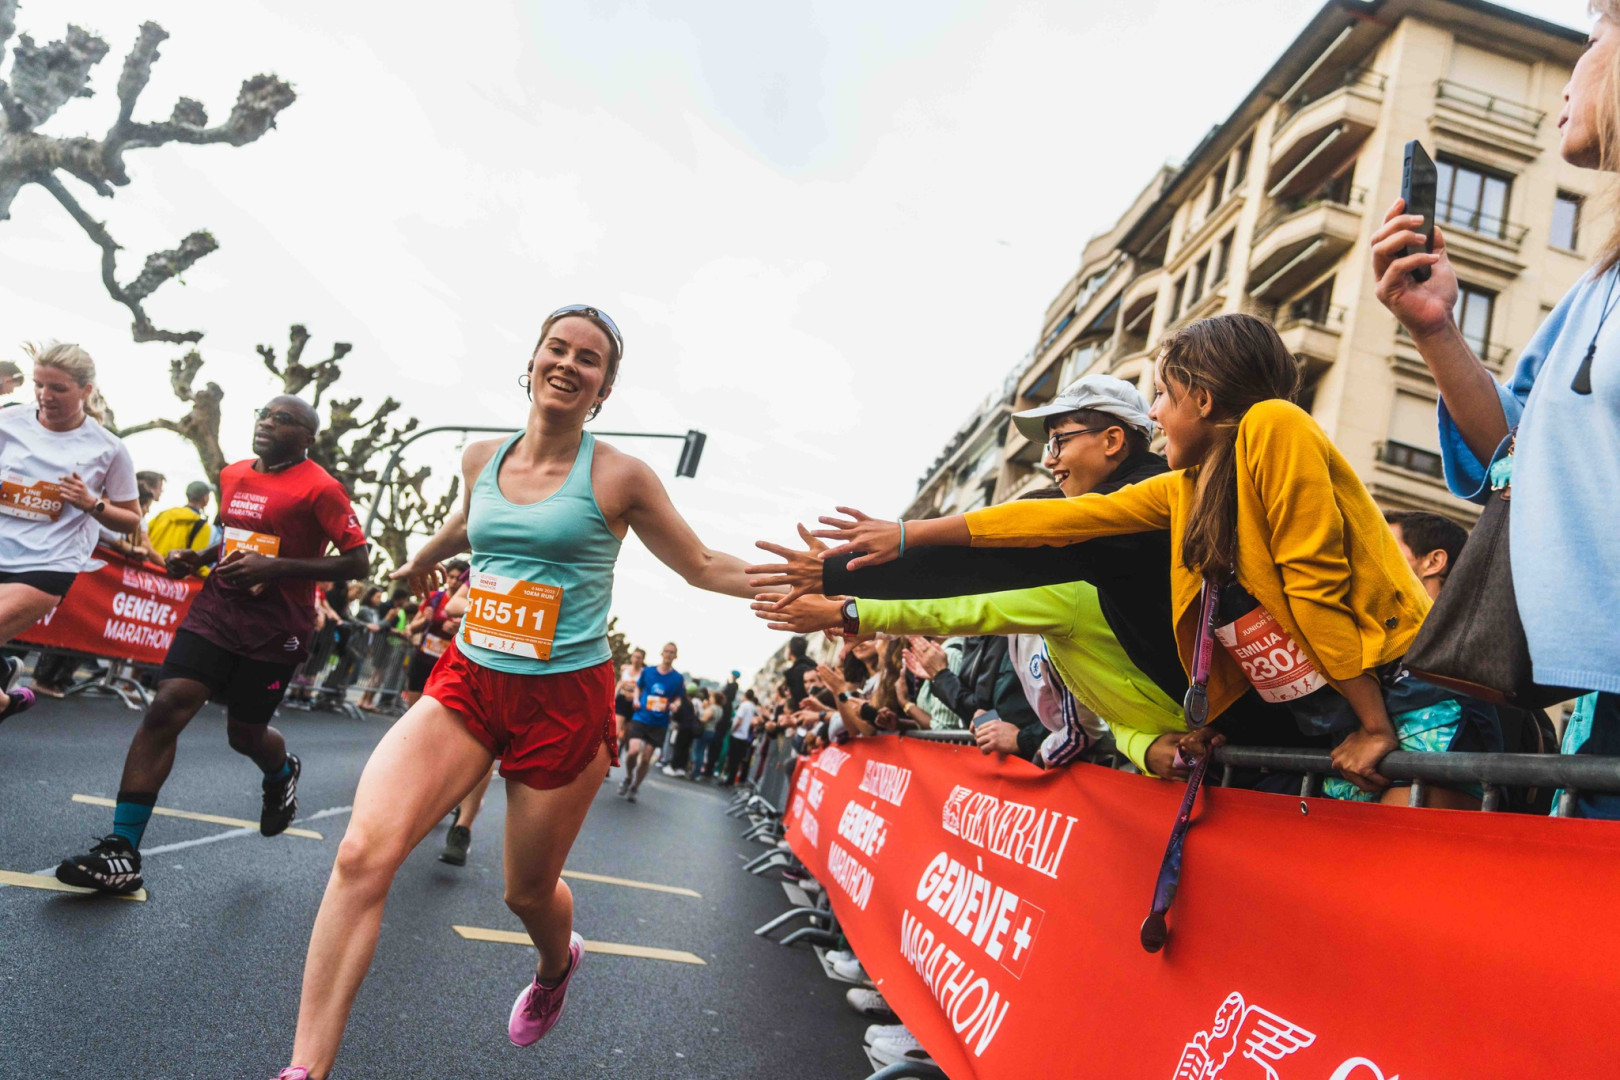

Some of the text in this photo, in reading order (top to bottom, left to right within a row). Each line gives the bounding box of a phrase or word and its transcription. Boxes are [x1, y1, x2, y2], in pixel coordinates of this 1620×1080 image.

[13, 492, 63, 512] 14289
[23, 488, 42, 497] LINE
[227, 508, 263, 519] MARATHON
[474, 596, 545, 631] 15511
[1241, 618, 1268, 637] JUNIOR
[103, 618, 174, 650] MARATHON
[1234, 632, 1283, 660] EMILIA
[960, 791, 1079, 880] GENERALI
[827, 841, 875, 911] MARATHON
[900, 910, 1010, 1058] MARATHON
